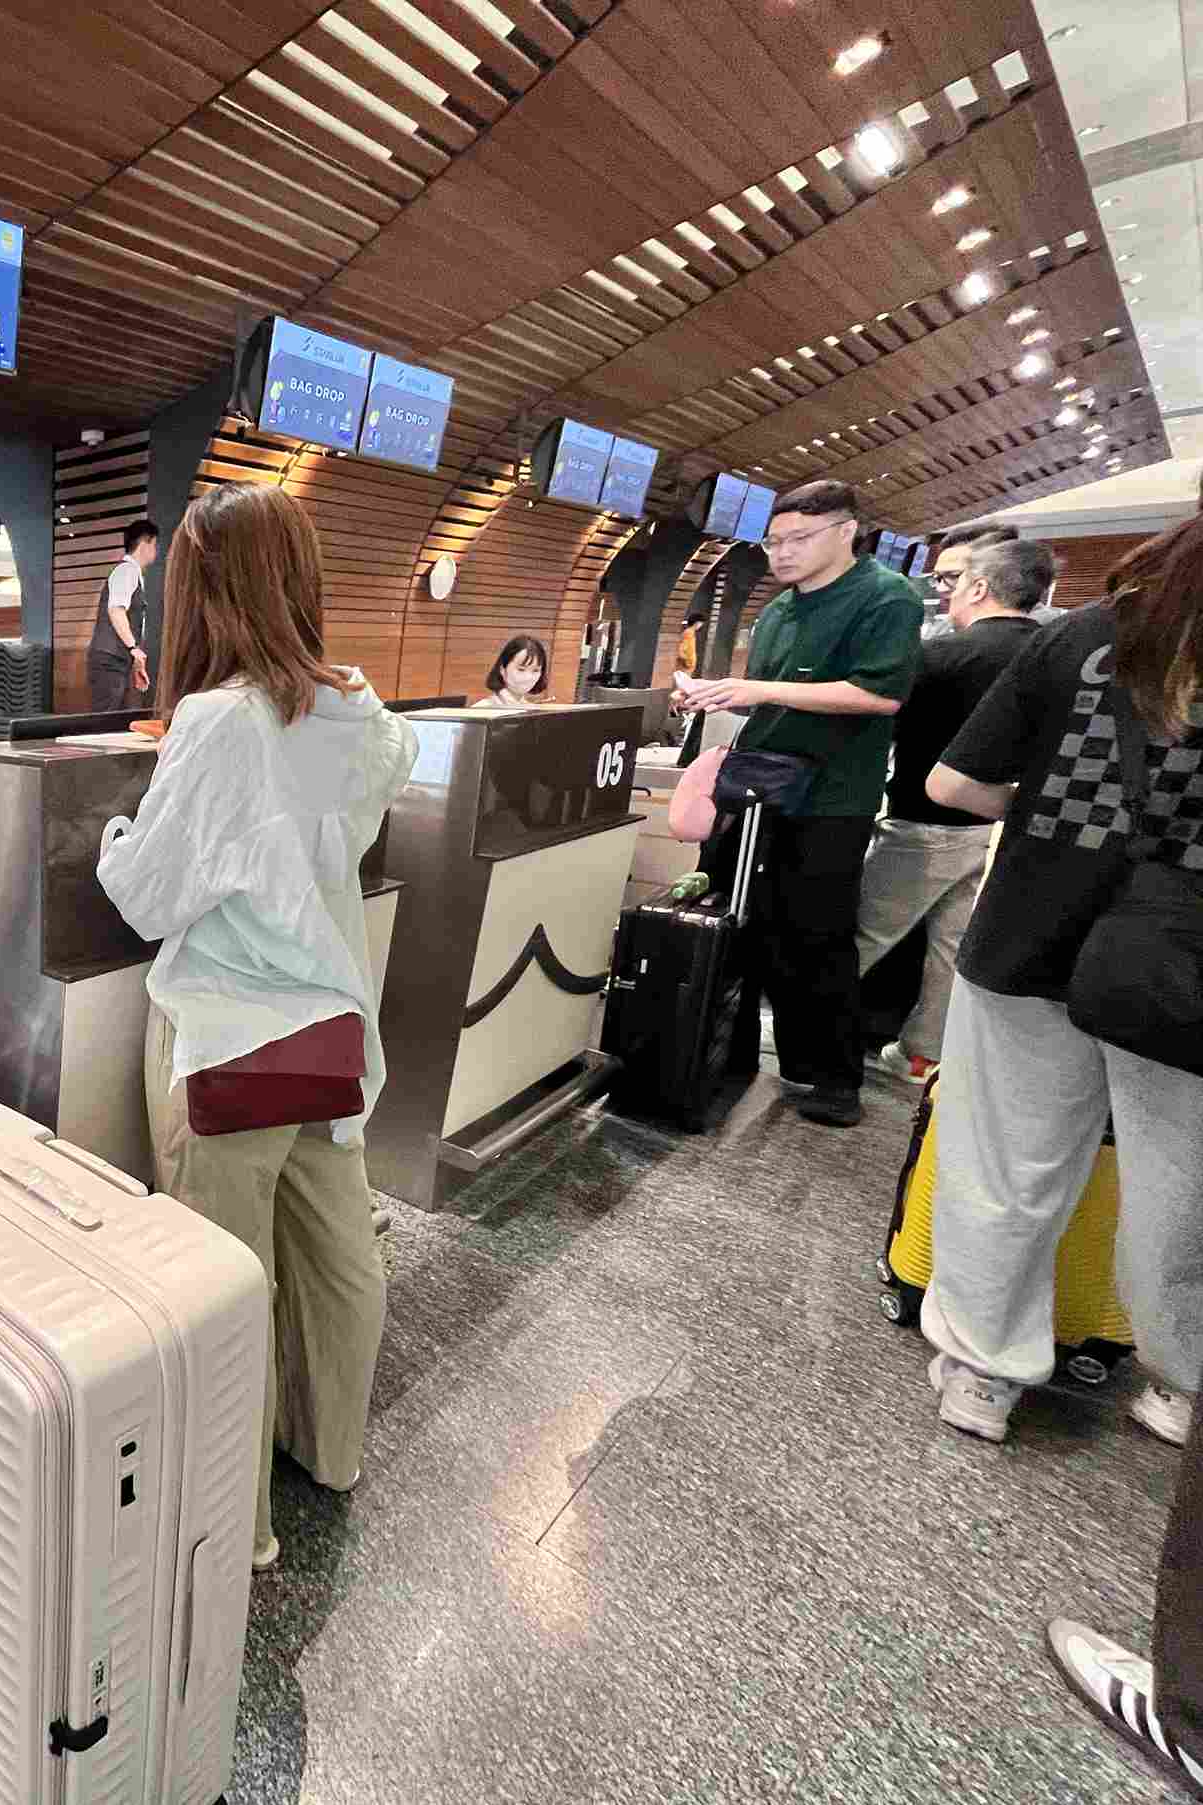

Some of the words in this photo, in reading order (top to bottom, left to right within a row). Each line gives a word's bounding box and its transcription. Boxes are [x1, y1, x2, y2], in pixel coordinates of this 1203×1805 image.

[290, 377, 313, 394] BAG
[315, 385, 345, 402] DROP
[597, 740, 626, 788] 05
